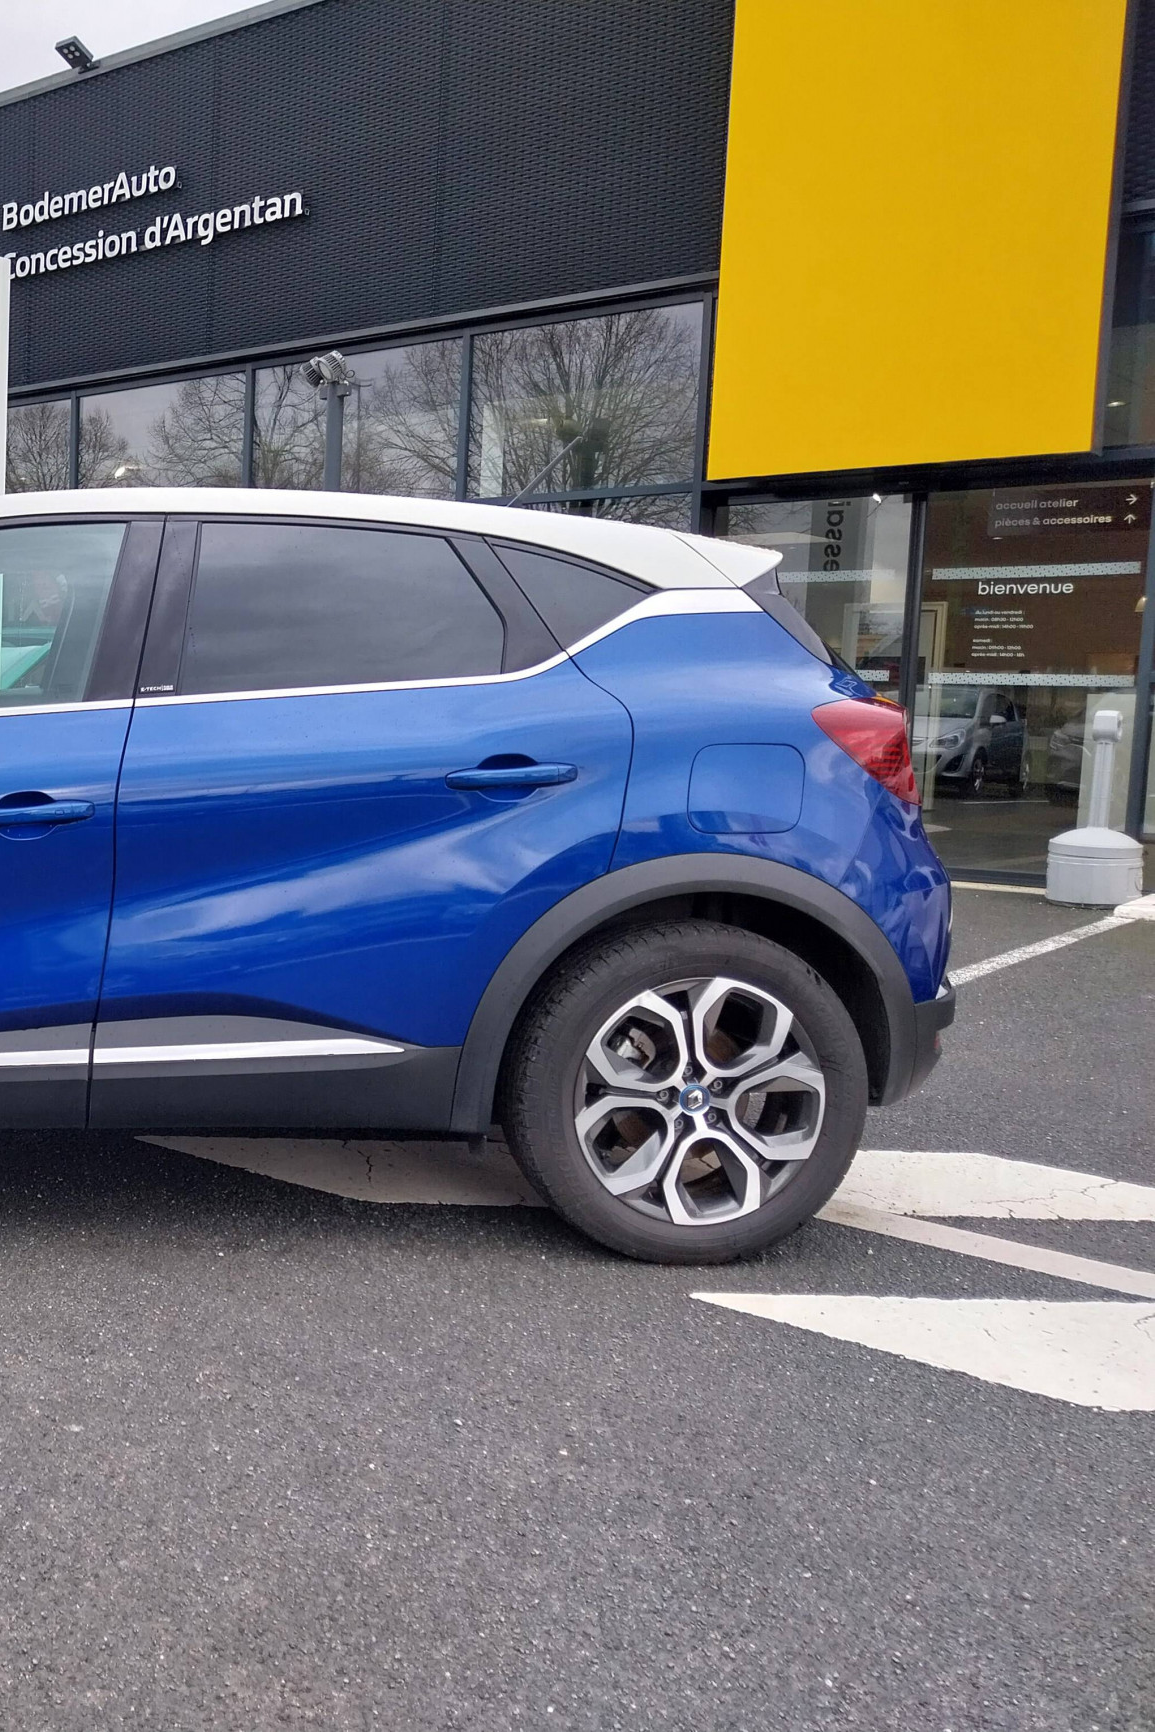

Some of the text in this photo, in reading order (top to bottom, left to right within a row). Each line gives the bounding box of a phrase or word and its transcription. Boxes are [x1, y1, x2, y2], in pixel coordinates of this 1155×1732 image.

[1, 165, 177, 231] BodemerAuto
[1039, 498, 1079, 508] atelier
[1042, 514, 1112, 526] accessoires
[977, 581, 1074, 596] bienvenue
